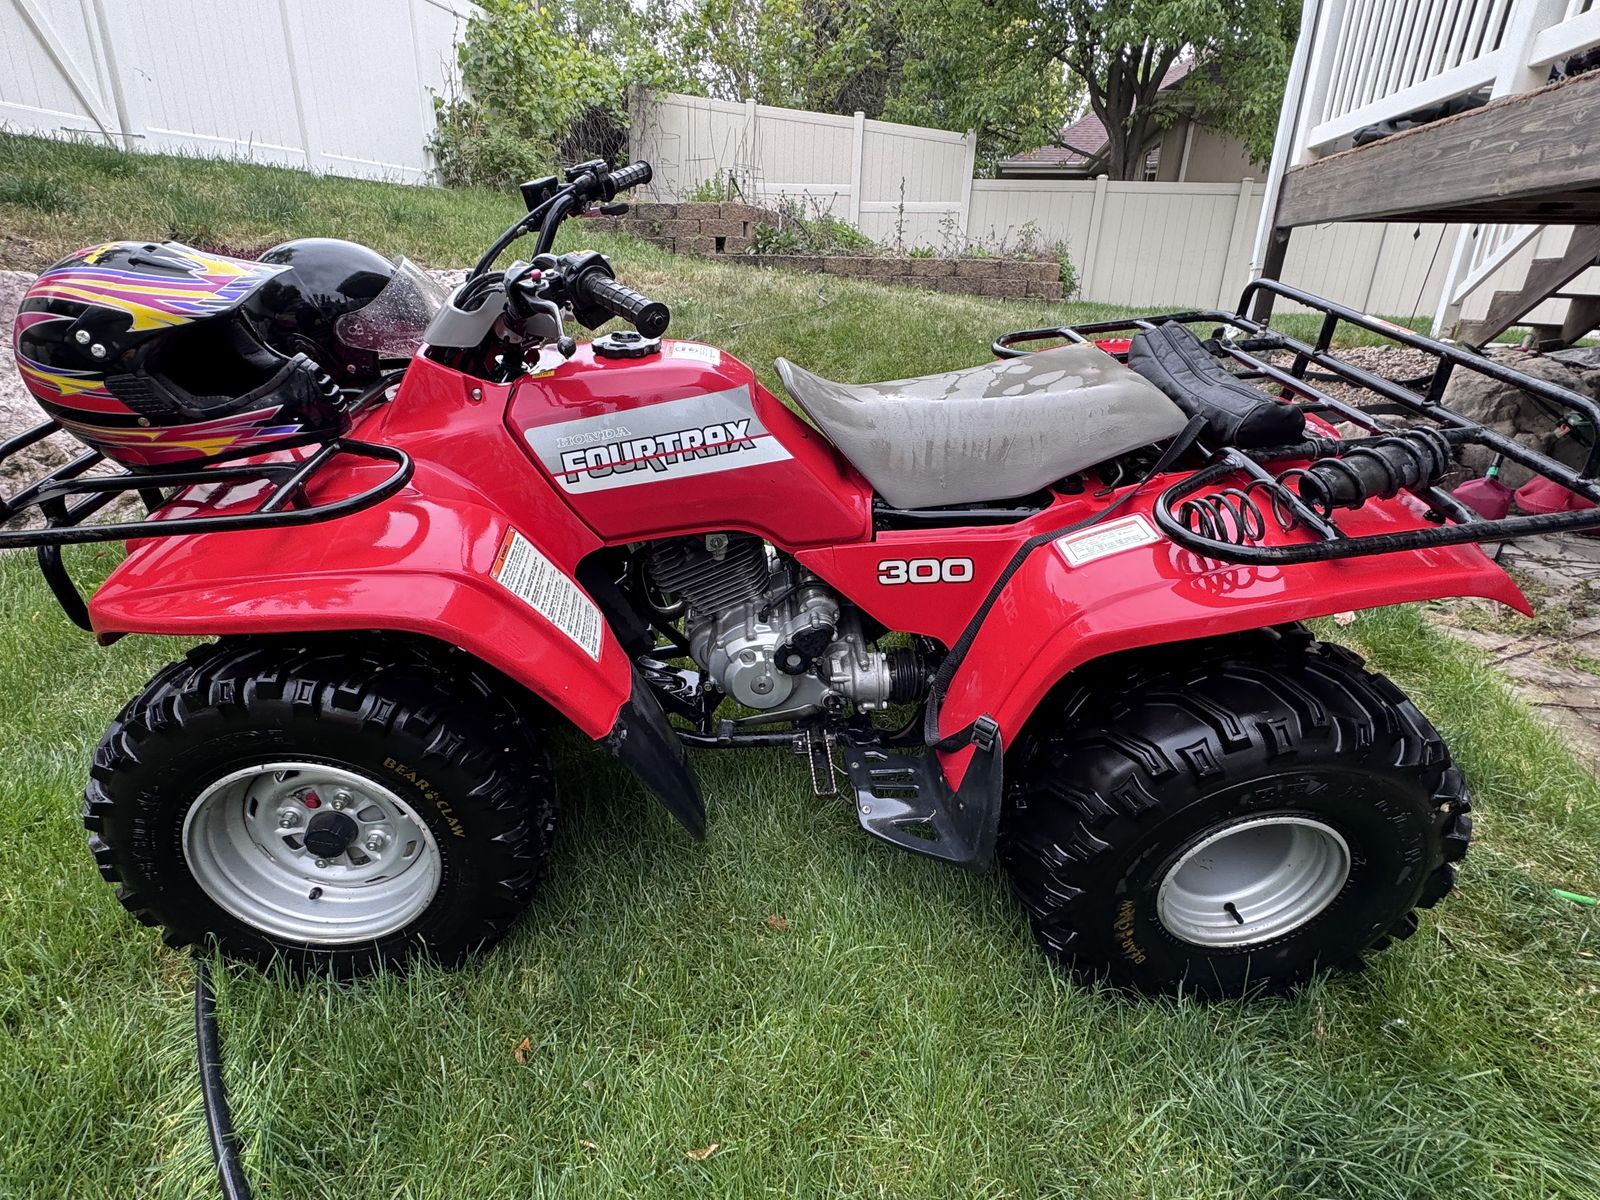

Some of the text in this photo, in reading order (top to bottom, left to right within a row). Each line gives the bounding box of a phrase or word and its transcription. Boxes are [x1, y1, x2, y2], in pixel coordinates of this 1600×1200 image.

[556, 426, 632, 448] HONDA
[560, 418, 757, 484] FOURTRAX
[877, 557, 975, 585] 300
[383, 757, 466, 838] BEAR CLAW
